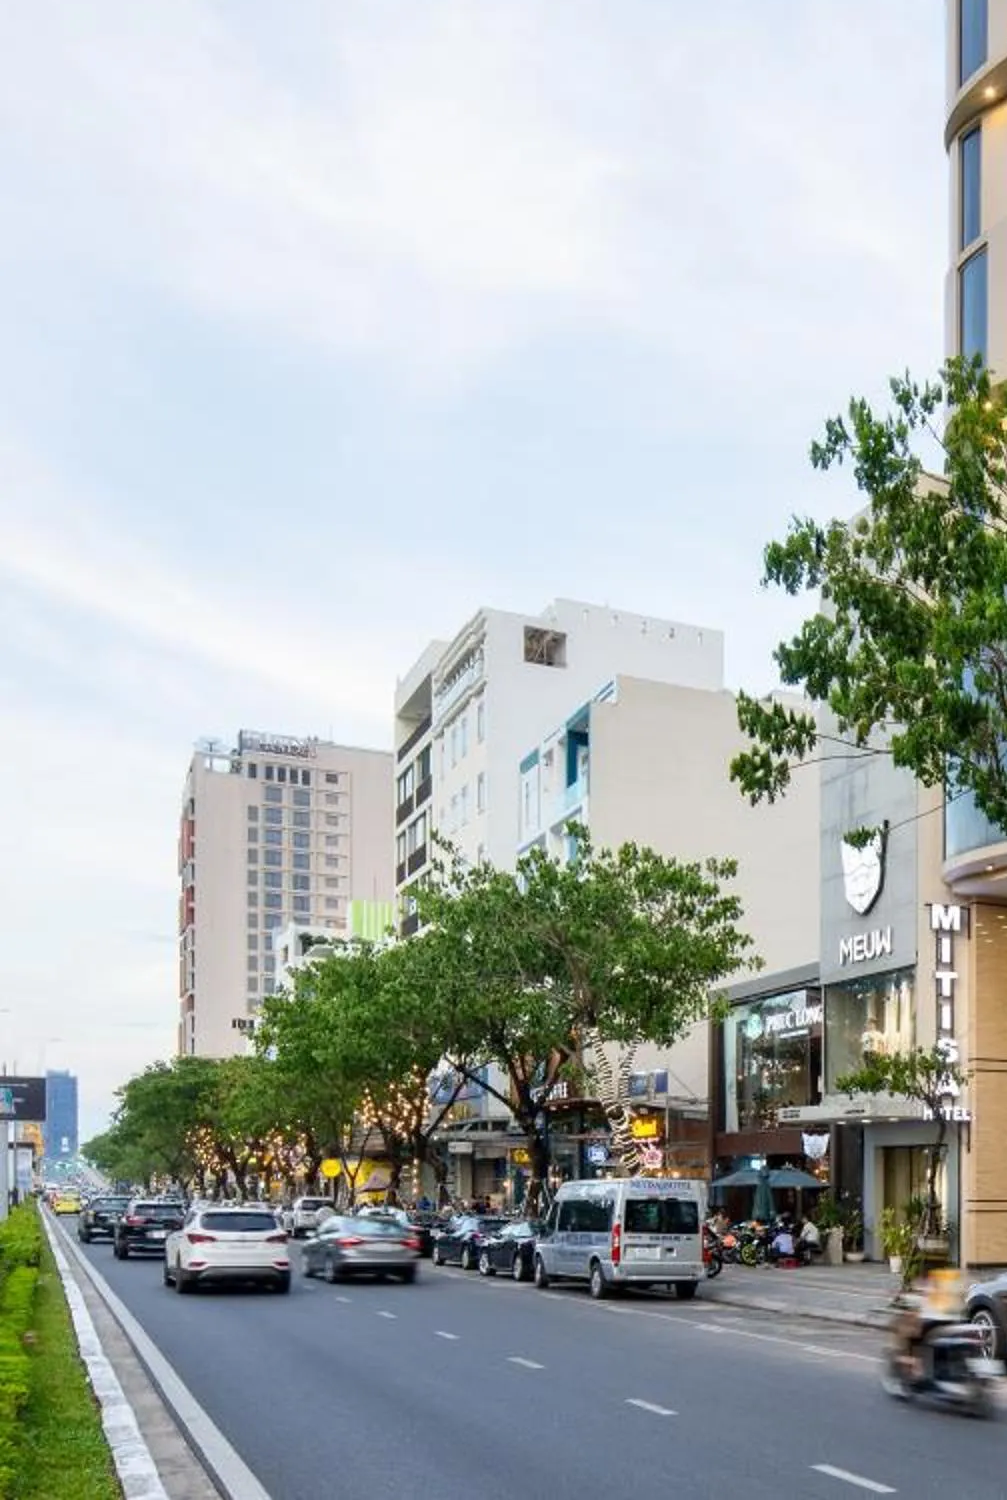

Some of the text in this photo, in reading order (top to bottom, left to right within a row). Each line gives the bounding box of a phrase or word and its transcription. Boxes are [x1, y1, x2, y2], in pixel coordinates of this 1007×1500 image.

[840, 924, 892, 965] MEUW
[930, 904, 961, 1096] MITISA
[923, 1105, 972, 1122] HTEL
